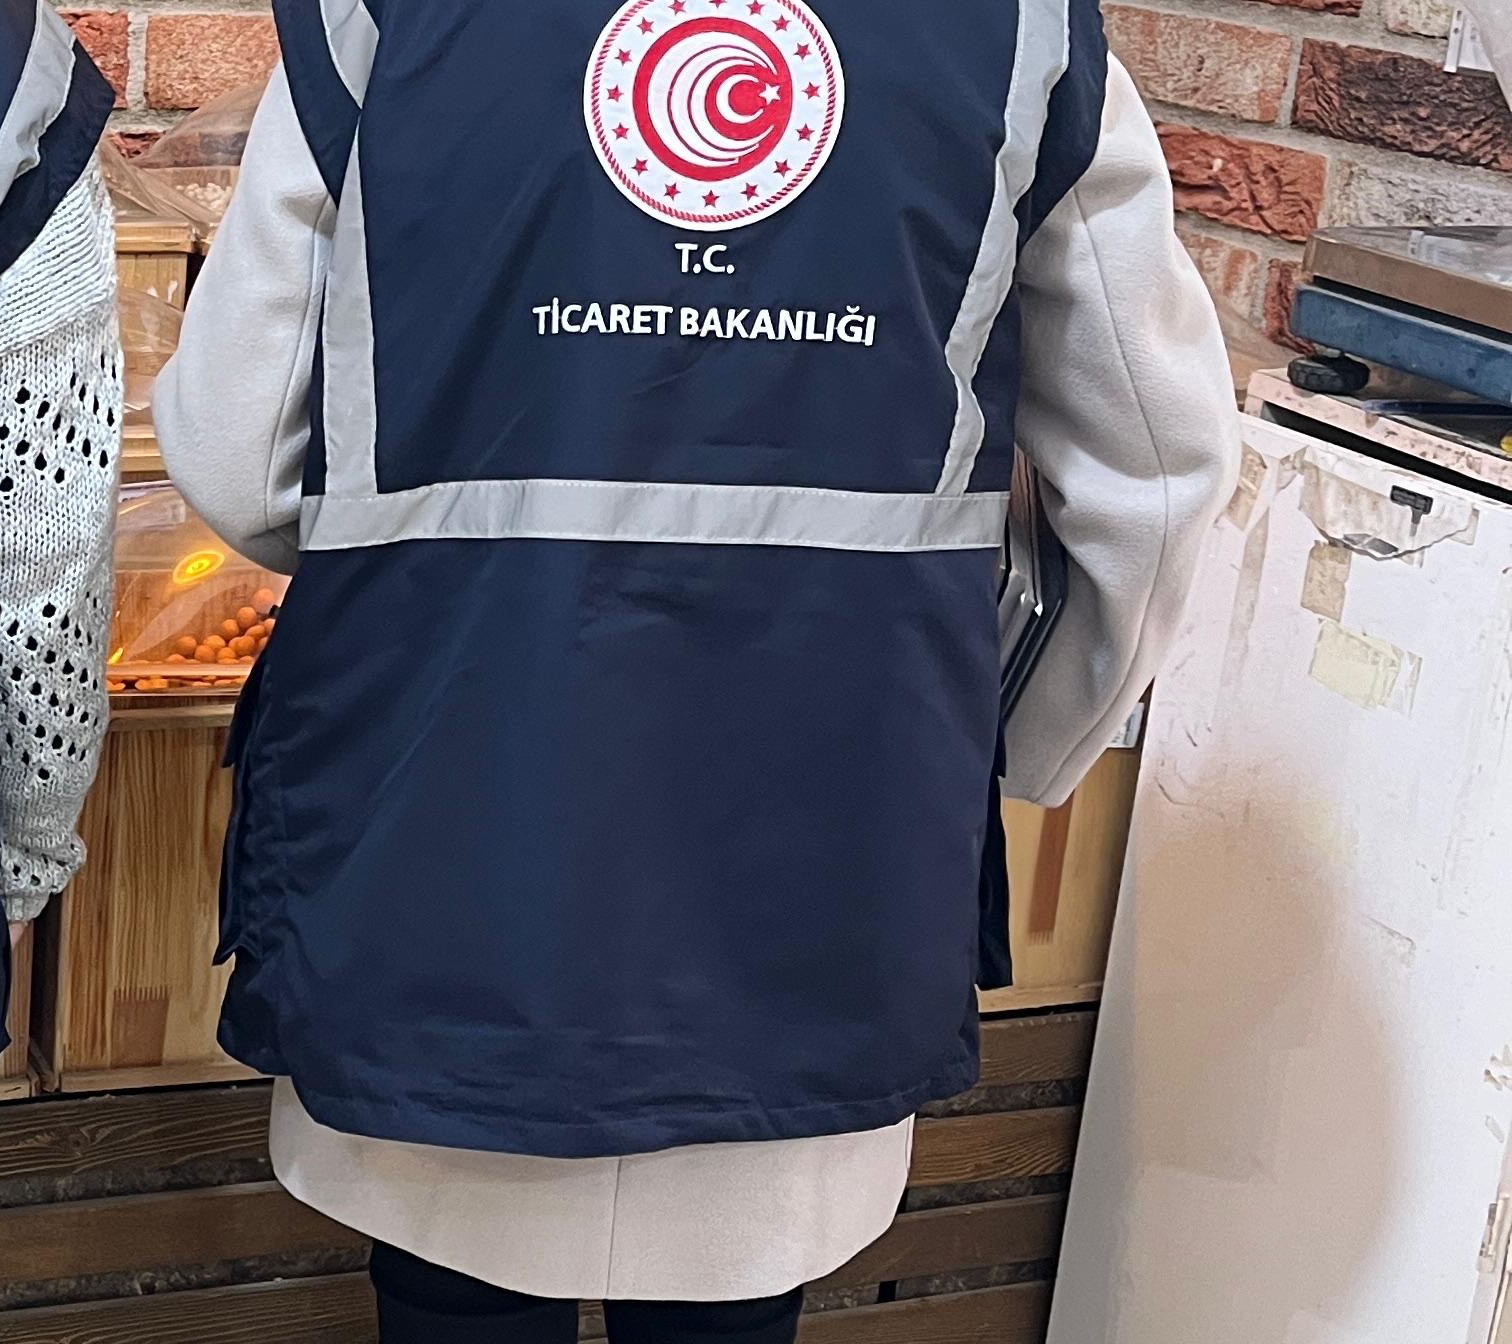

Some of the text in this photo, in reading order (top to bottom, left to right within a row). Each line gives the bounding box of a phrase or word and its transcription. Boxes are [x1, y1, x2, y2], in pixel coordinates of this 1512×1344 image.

[674, 242, 735, 275] T.C.
[532, 297, 877, 347] TİCARET BAKANLIĞI
